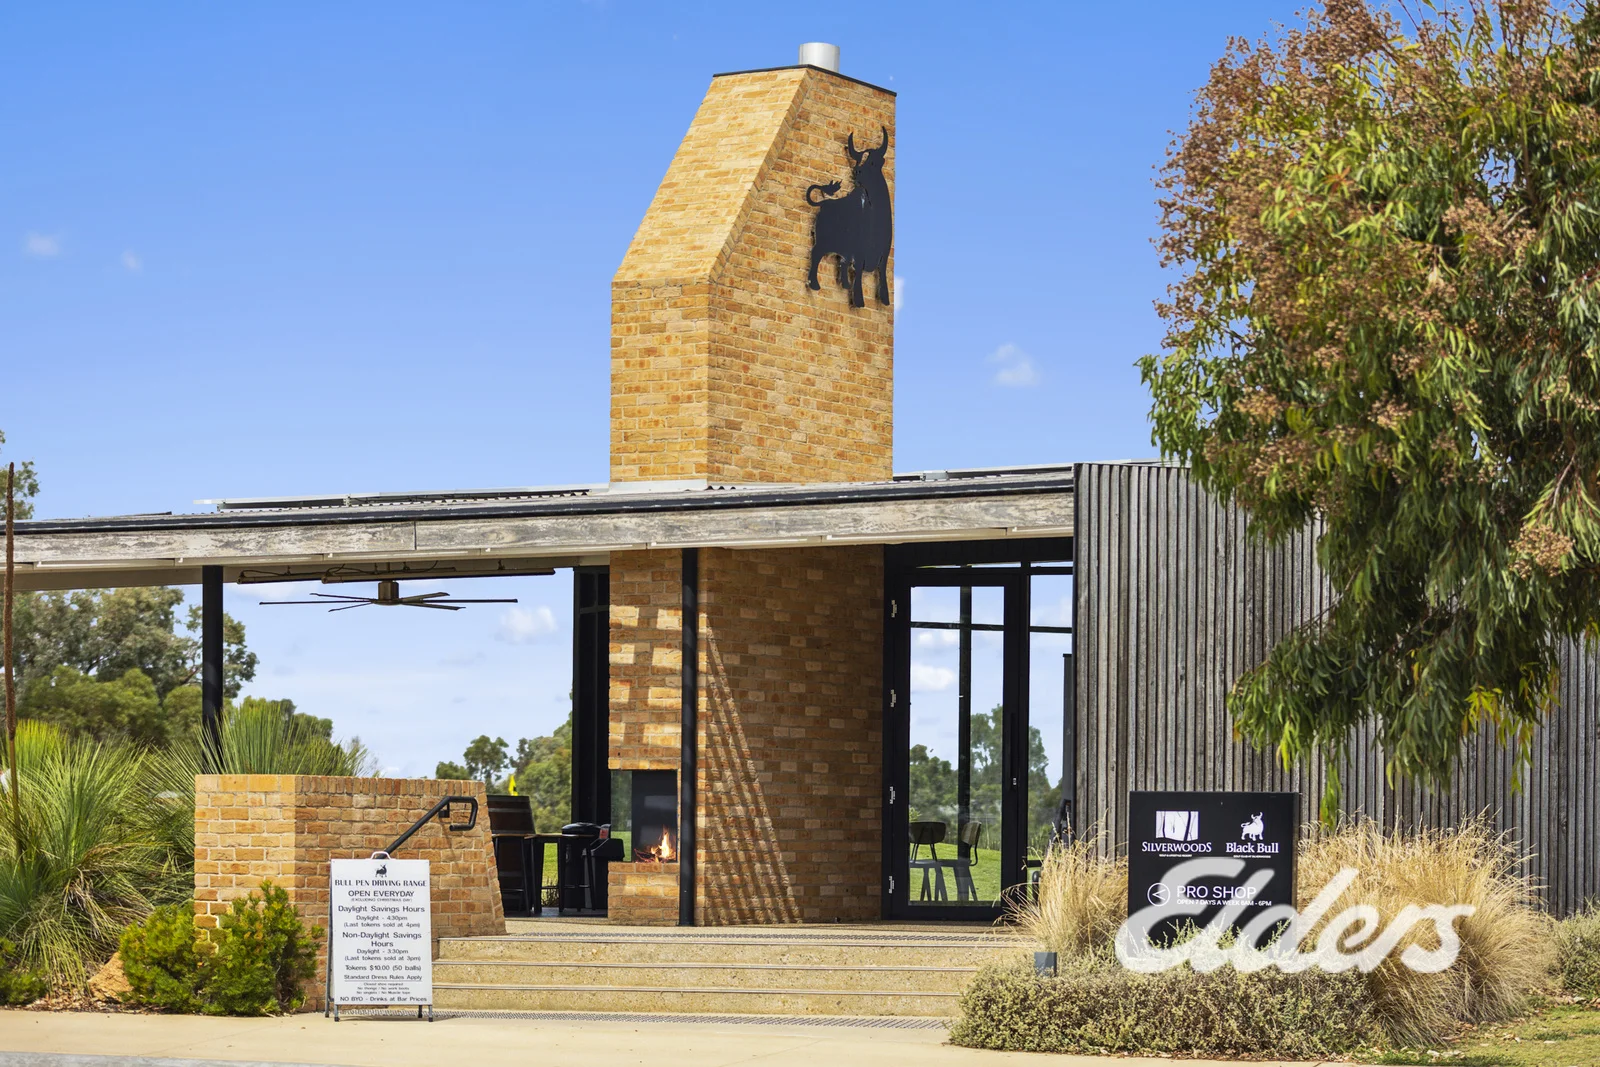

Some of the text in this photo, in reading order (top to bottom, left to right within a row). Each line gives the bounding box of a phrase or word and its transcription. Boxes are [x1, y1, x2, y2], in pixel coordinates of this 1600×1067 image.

[1226, 842, 1279, 853] Black Bull
[1177, 886, 1256, 898] PRO SHOP
